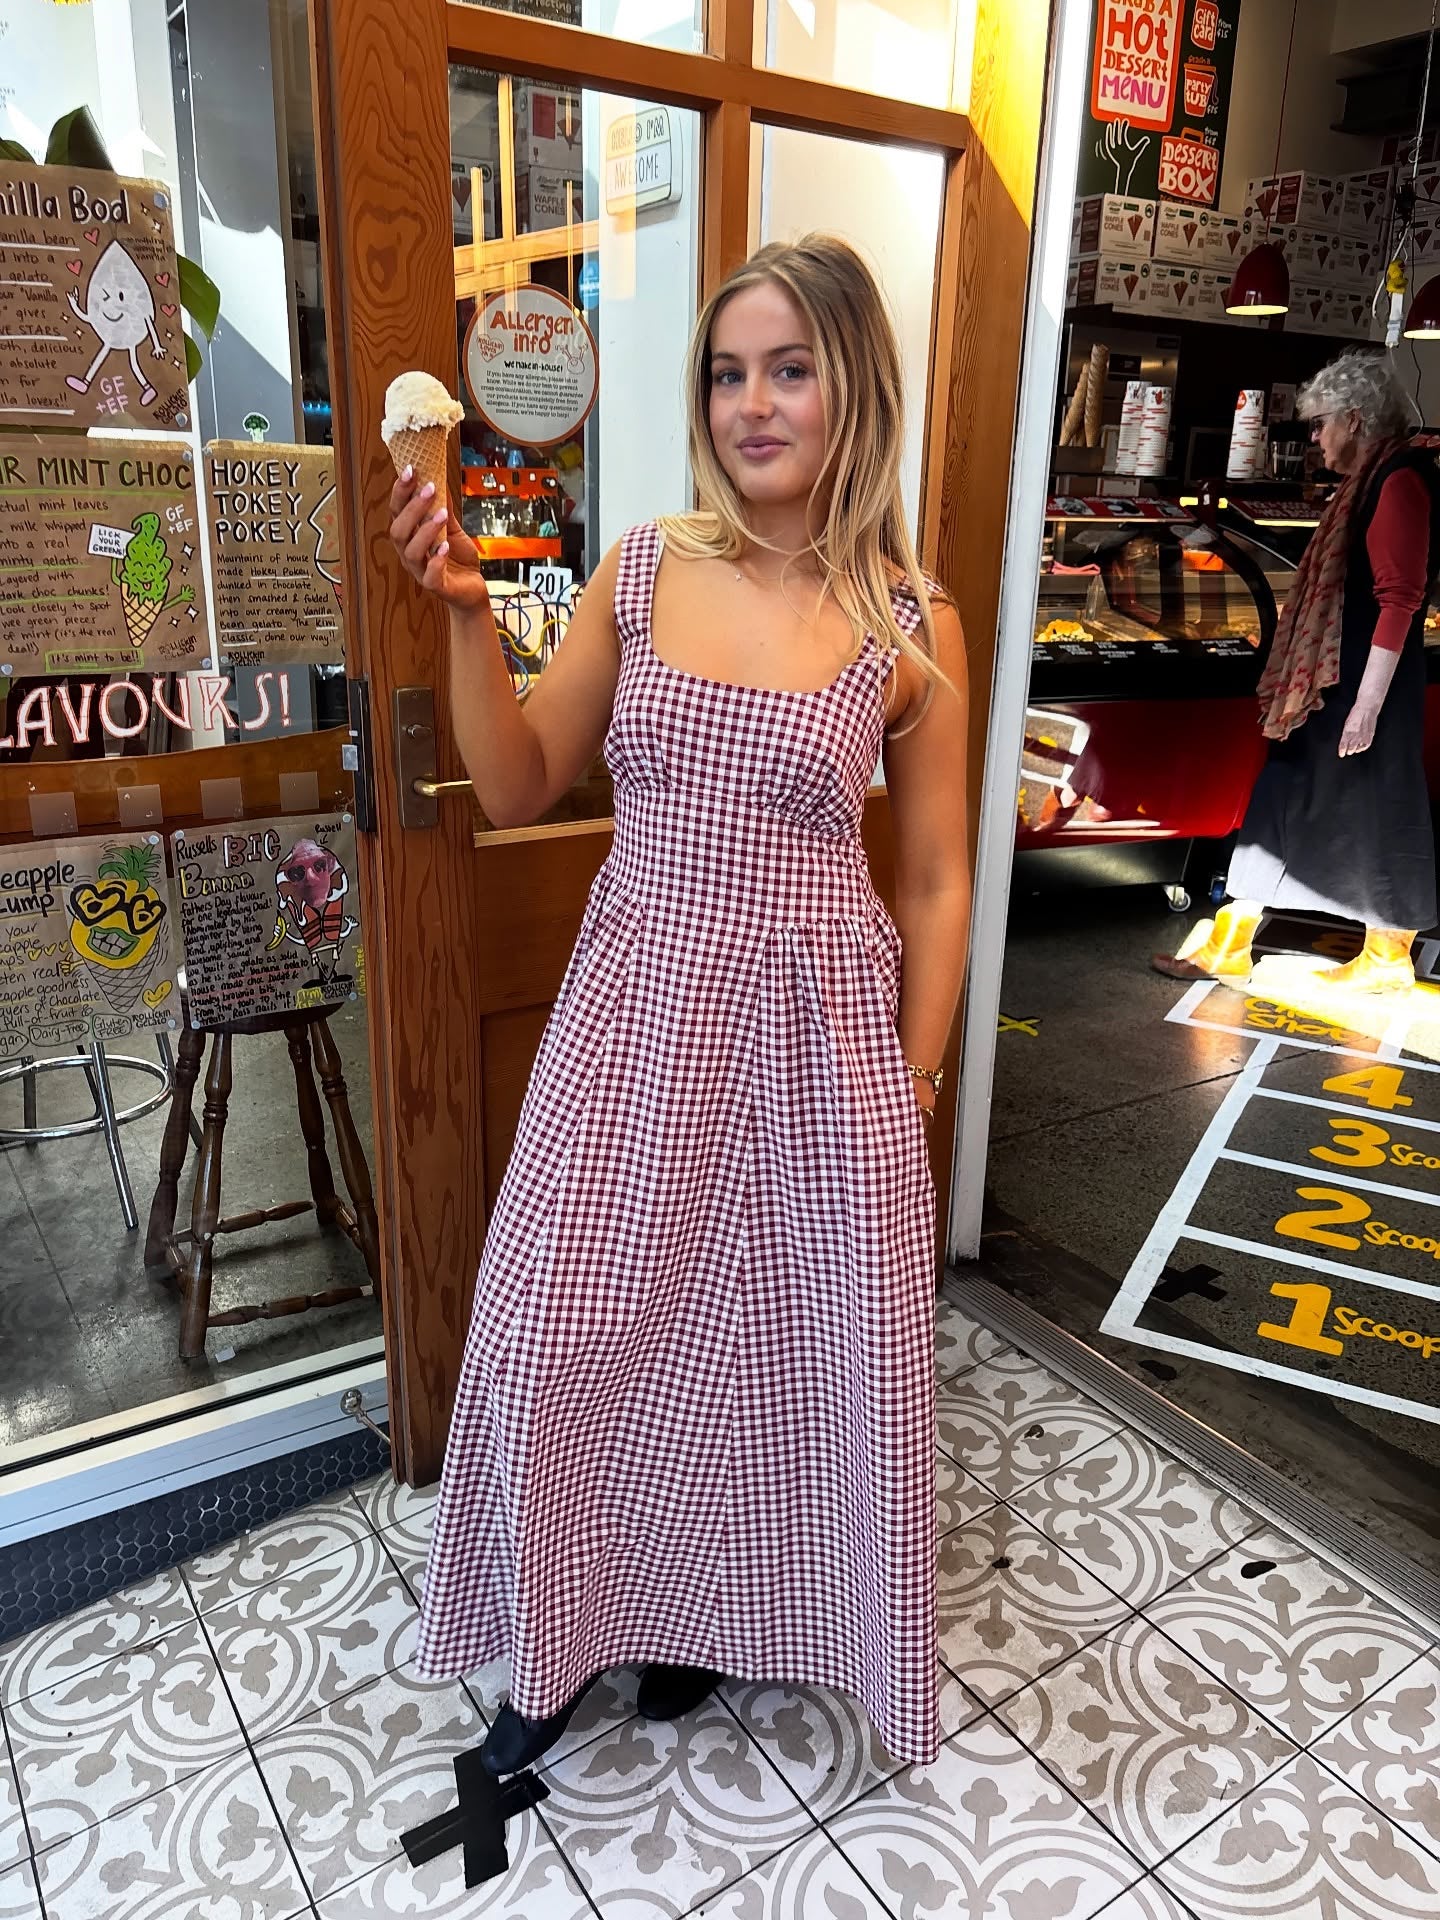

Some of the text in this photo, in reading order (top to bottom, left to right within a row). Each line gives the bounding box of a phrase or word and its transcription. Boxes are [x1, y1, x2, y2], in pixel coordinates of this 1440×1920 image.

[1195, 8, 1215, 27] Gift
[613, 152, 660, 189] AWESOME
[1159, 162, 1214, 200] BOX
[68, 185, 131, 225] Bod
[534, 193, 565, 206] WAFFLE
[534, 204, 566, 217] CONES
[1104, 222, 1124, 232] CONES
[43, 230, 76, 246] bean
[16, 308, 46, 322] gives
[19, 325, 61, 337] STARS
[31, 342, 84, 355] delicious
[10, 358, 57, 369] absolute
[100, 376, 125, 396] GF
[26, 392, 69, 408] lovers!!
[37, 457, 111, 488] MINT
[118, 460, 192, 490] CHOC
[211, 459, 301, 488] HOKEY
[38, 498, 109, 513] mint leaves
[212, 490, 304, 516] TOKEY
[165, 504, 185, 522] GF
[10, 518, 86, 535] milk whipped
[98, 528, 121, 539] LICK
[215, 519, 303, 545] POKEY
[44, 536, 70, 549] real
[98, 538, 121, 548] YOUR
[217, 552, 309, 564] Mountains of house
[48, 570, 75, 581] with
[217, 567, 244, 576] made
[250, 567, 277, 580] Hokey
[31, 587, 57, 598] choc
[67, 584, 110, 596] chunks!
[217, 580, 251, 590] dunked
[218, 593, 240, 604] then
[248, 593, 288, 603] smashed
[304, 592, 329, 603] folded
[31, 602, 67, 616] closely
[72, 602, 84, 611] to
[219, 608, 239, 617] into
[245, 608, 261, 616] our
[266, 608, 298, 621] creamy
[1, 615, 96, 629] wee green pieces
[21, 629, 51, 640] mint
[79, 628, 93, 636] the
[97, 627, 117, 636] real
[264, 633, 285, 642] done
[290, 634, 305, 642] our
[75, 652, 100, 663] mint
[104, 653, 115, 662] to
[0, 671, 291, 749] AVOURS!
[175, 829, 281, 868] Russells BIG
[178, 862, 255, 900] Banana
[215, 892, 266, 911] Day flavour
[197, 912, 212, 922] one
[253, 898, 273, 913] Dad!
[230, 915, 256, 929] by his
[5, 922, 38, 942] your
[33, 962, 60, 979] real
[204, 962, 225, 975] built
[37, 977, 90, 997] goodness
[34, 996, 47, 1012] of
[94, 1016, 129, 1031] Gluten
[100, 1026, 127, 1038] FREE
[1321, 1064, 1413, 1109] 4
[1309, 1118, 1391, 1167] 3
[1274, 1187, 1373, 1250] 2
[1257, 1282, 1344, 1356] 1
